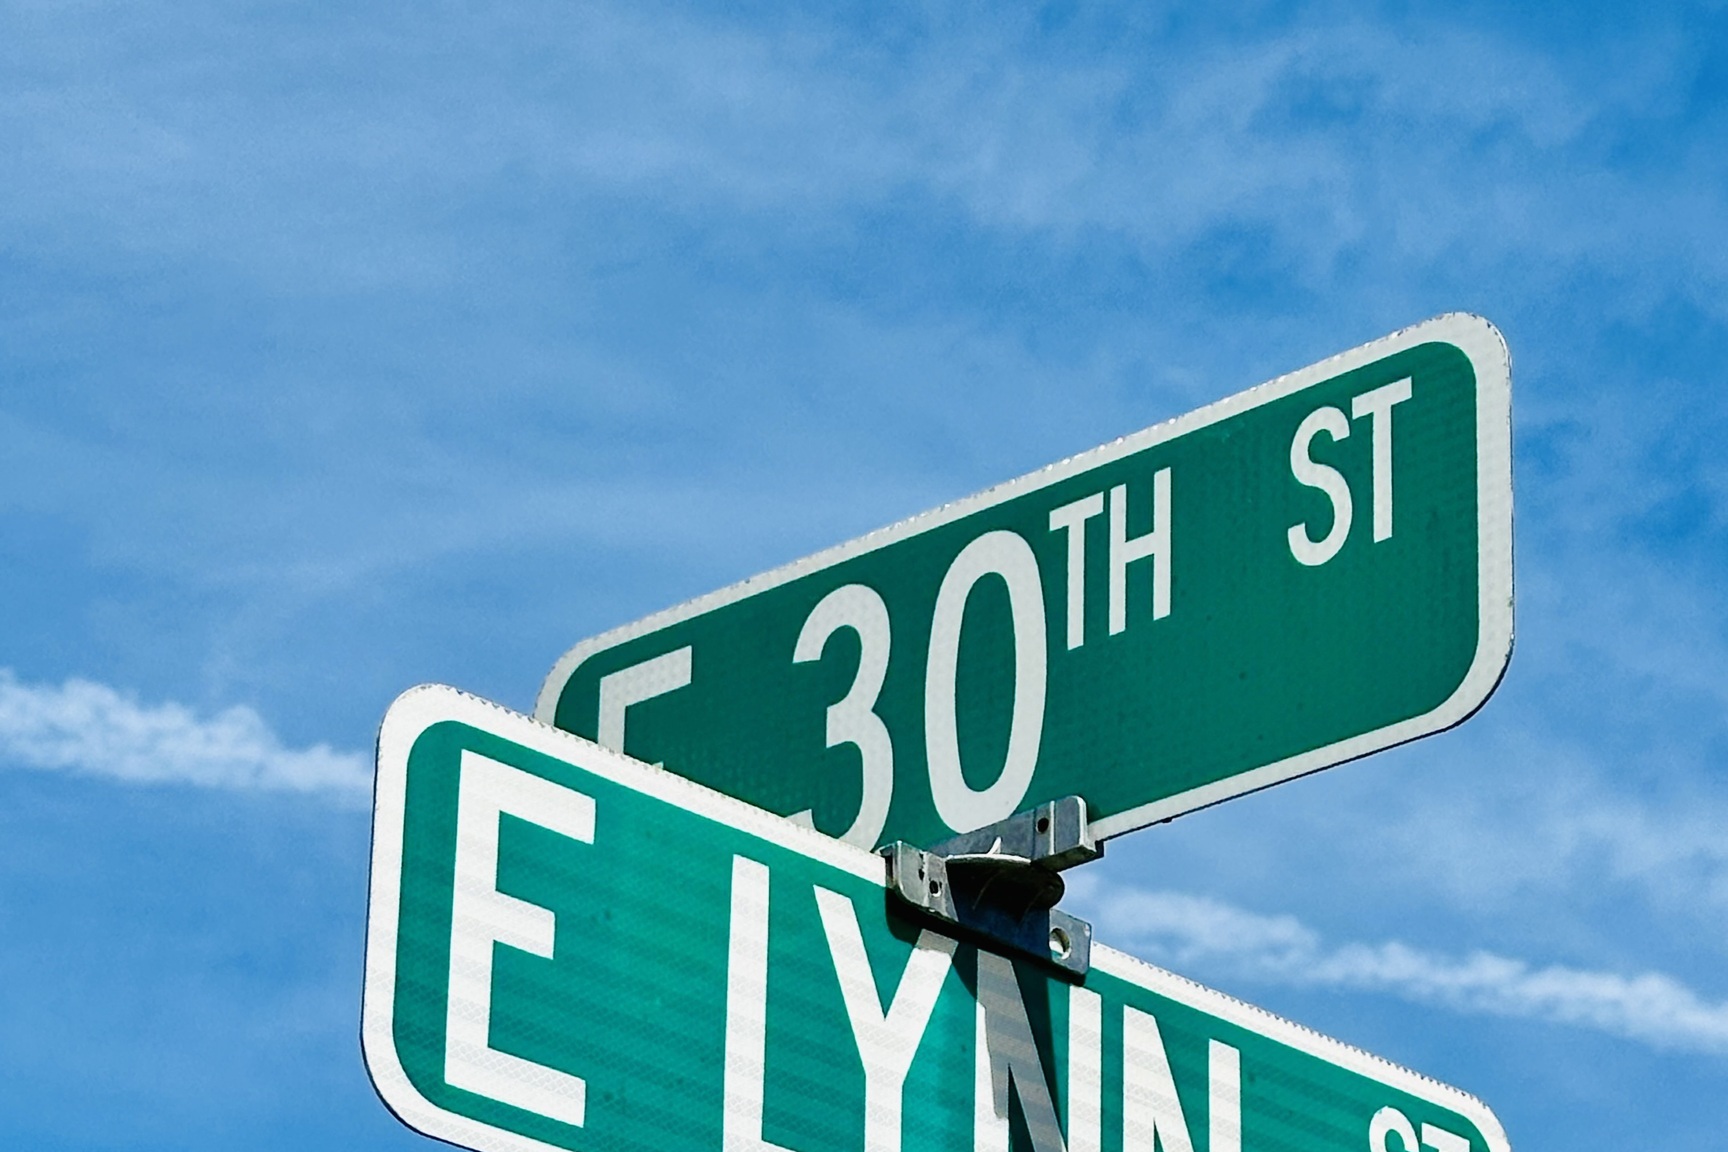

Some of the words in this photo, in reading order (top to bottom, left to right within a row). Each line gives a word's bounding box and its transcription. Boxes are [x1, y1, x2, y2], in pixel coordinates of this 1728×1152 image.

[792, 466, 1173, 851] 30TH
[1288, 377, 1412, 567] ST
[444, 749, 597, 1128] E
